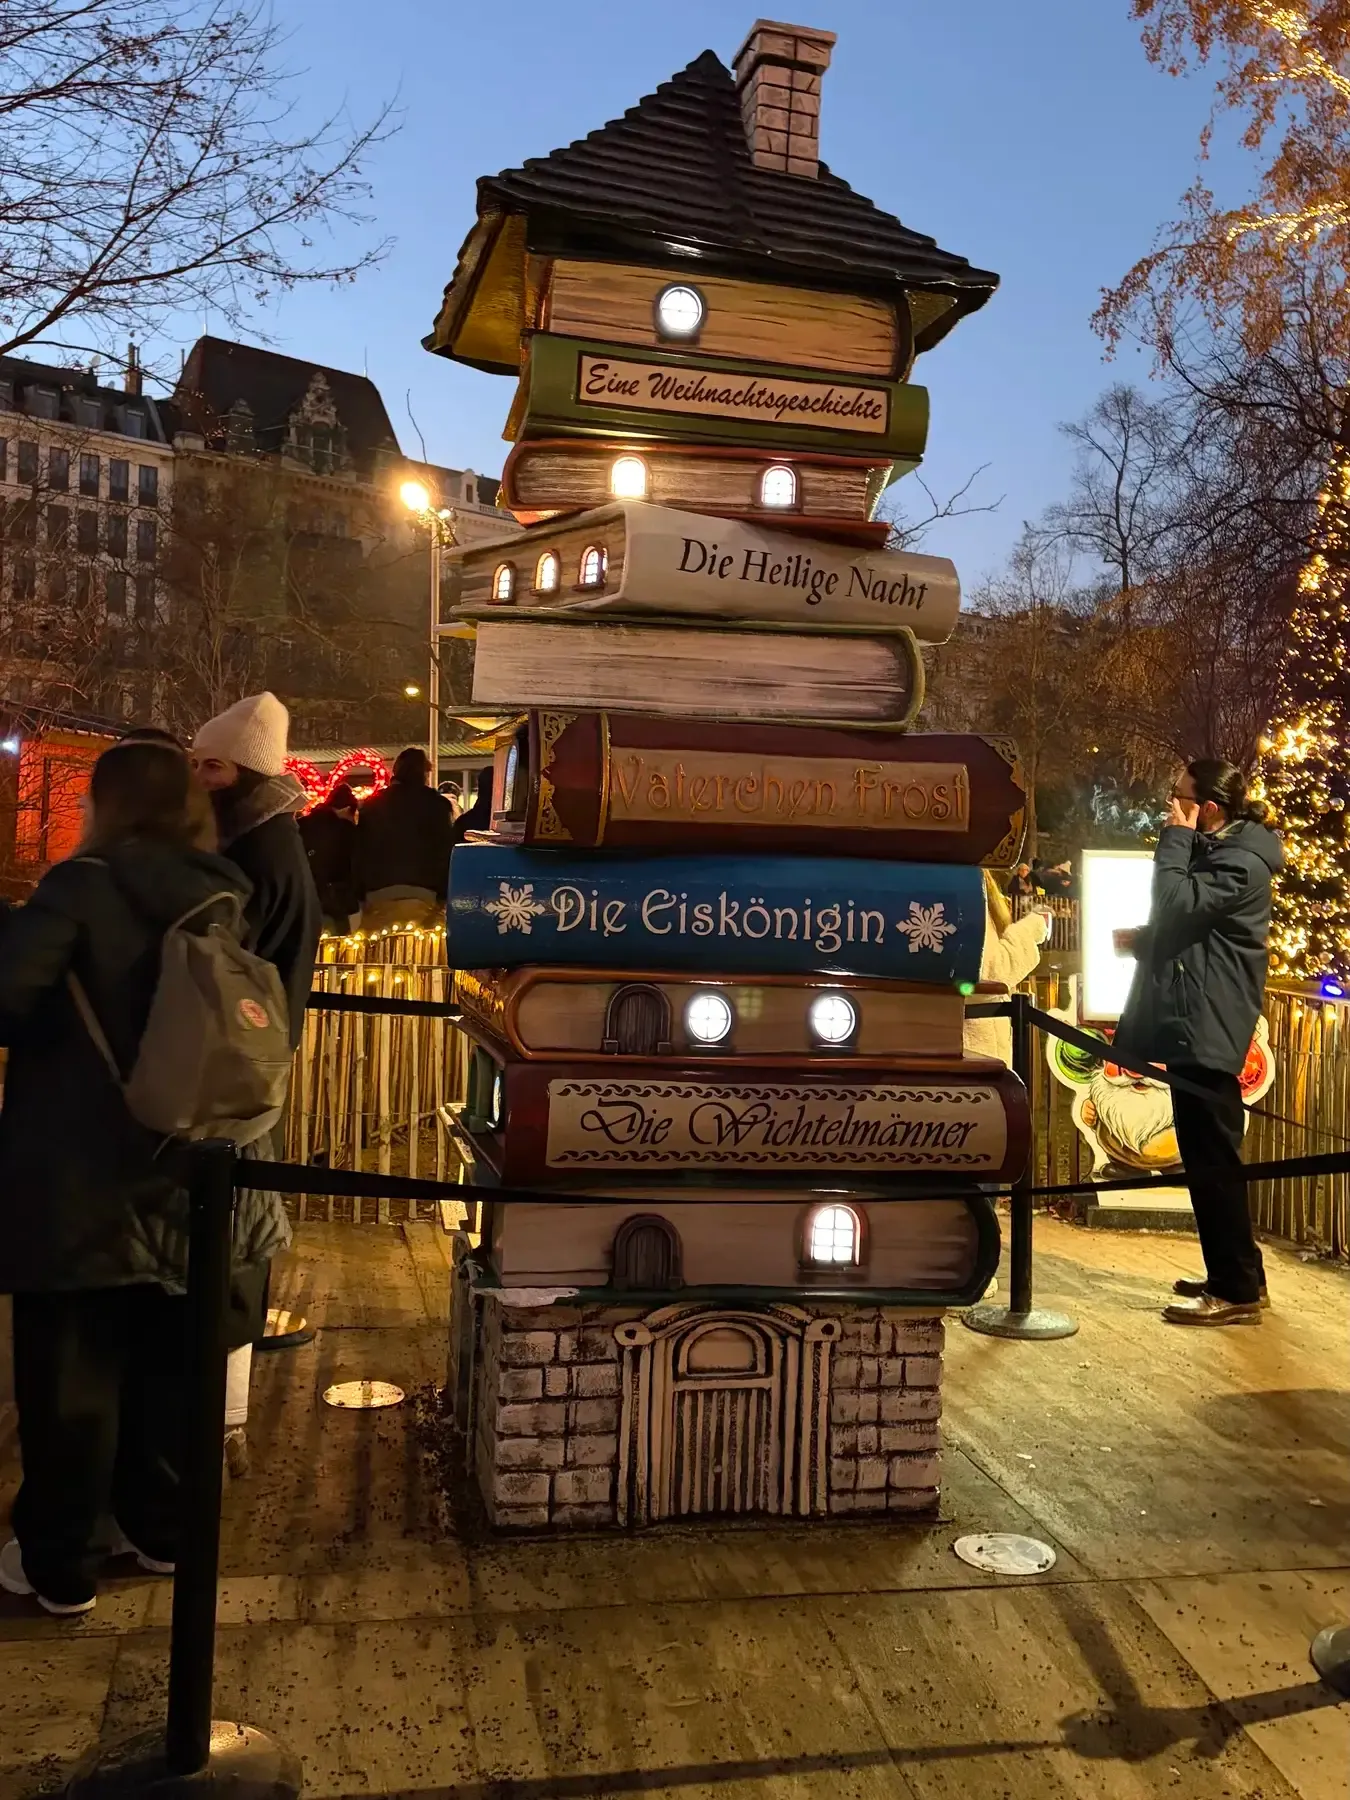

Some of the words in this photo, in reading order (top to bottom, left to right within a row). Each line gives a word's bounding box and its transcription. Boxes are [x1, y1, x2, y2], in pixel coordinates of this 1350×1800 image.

[585, 363, 640, 396] Eine
[649, 373, 883, 419] Weihnachtsgeschichte
[677, 538, 733, 578] Die
[739, 550, 839, 606] Heilige
[847, 566, 927, 610] Nacht
[855, 763, 967, 821] Frost
[551, 886, 627, 938] Die
[642, 889, 884, 953] Eiskönigin
[580, 1099, 673, 1146] Die
[688, 1102, 977, 1149] Wichtelmänner
